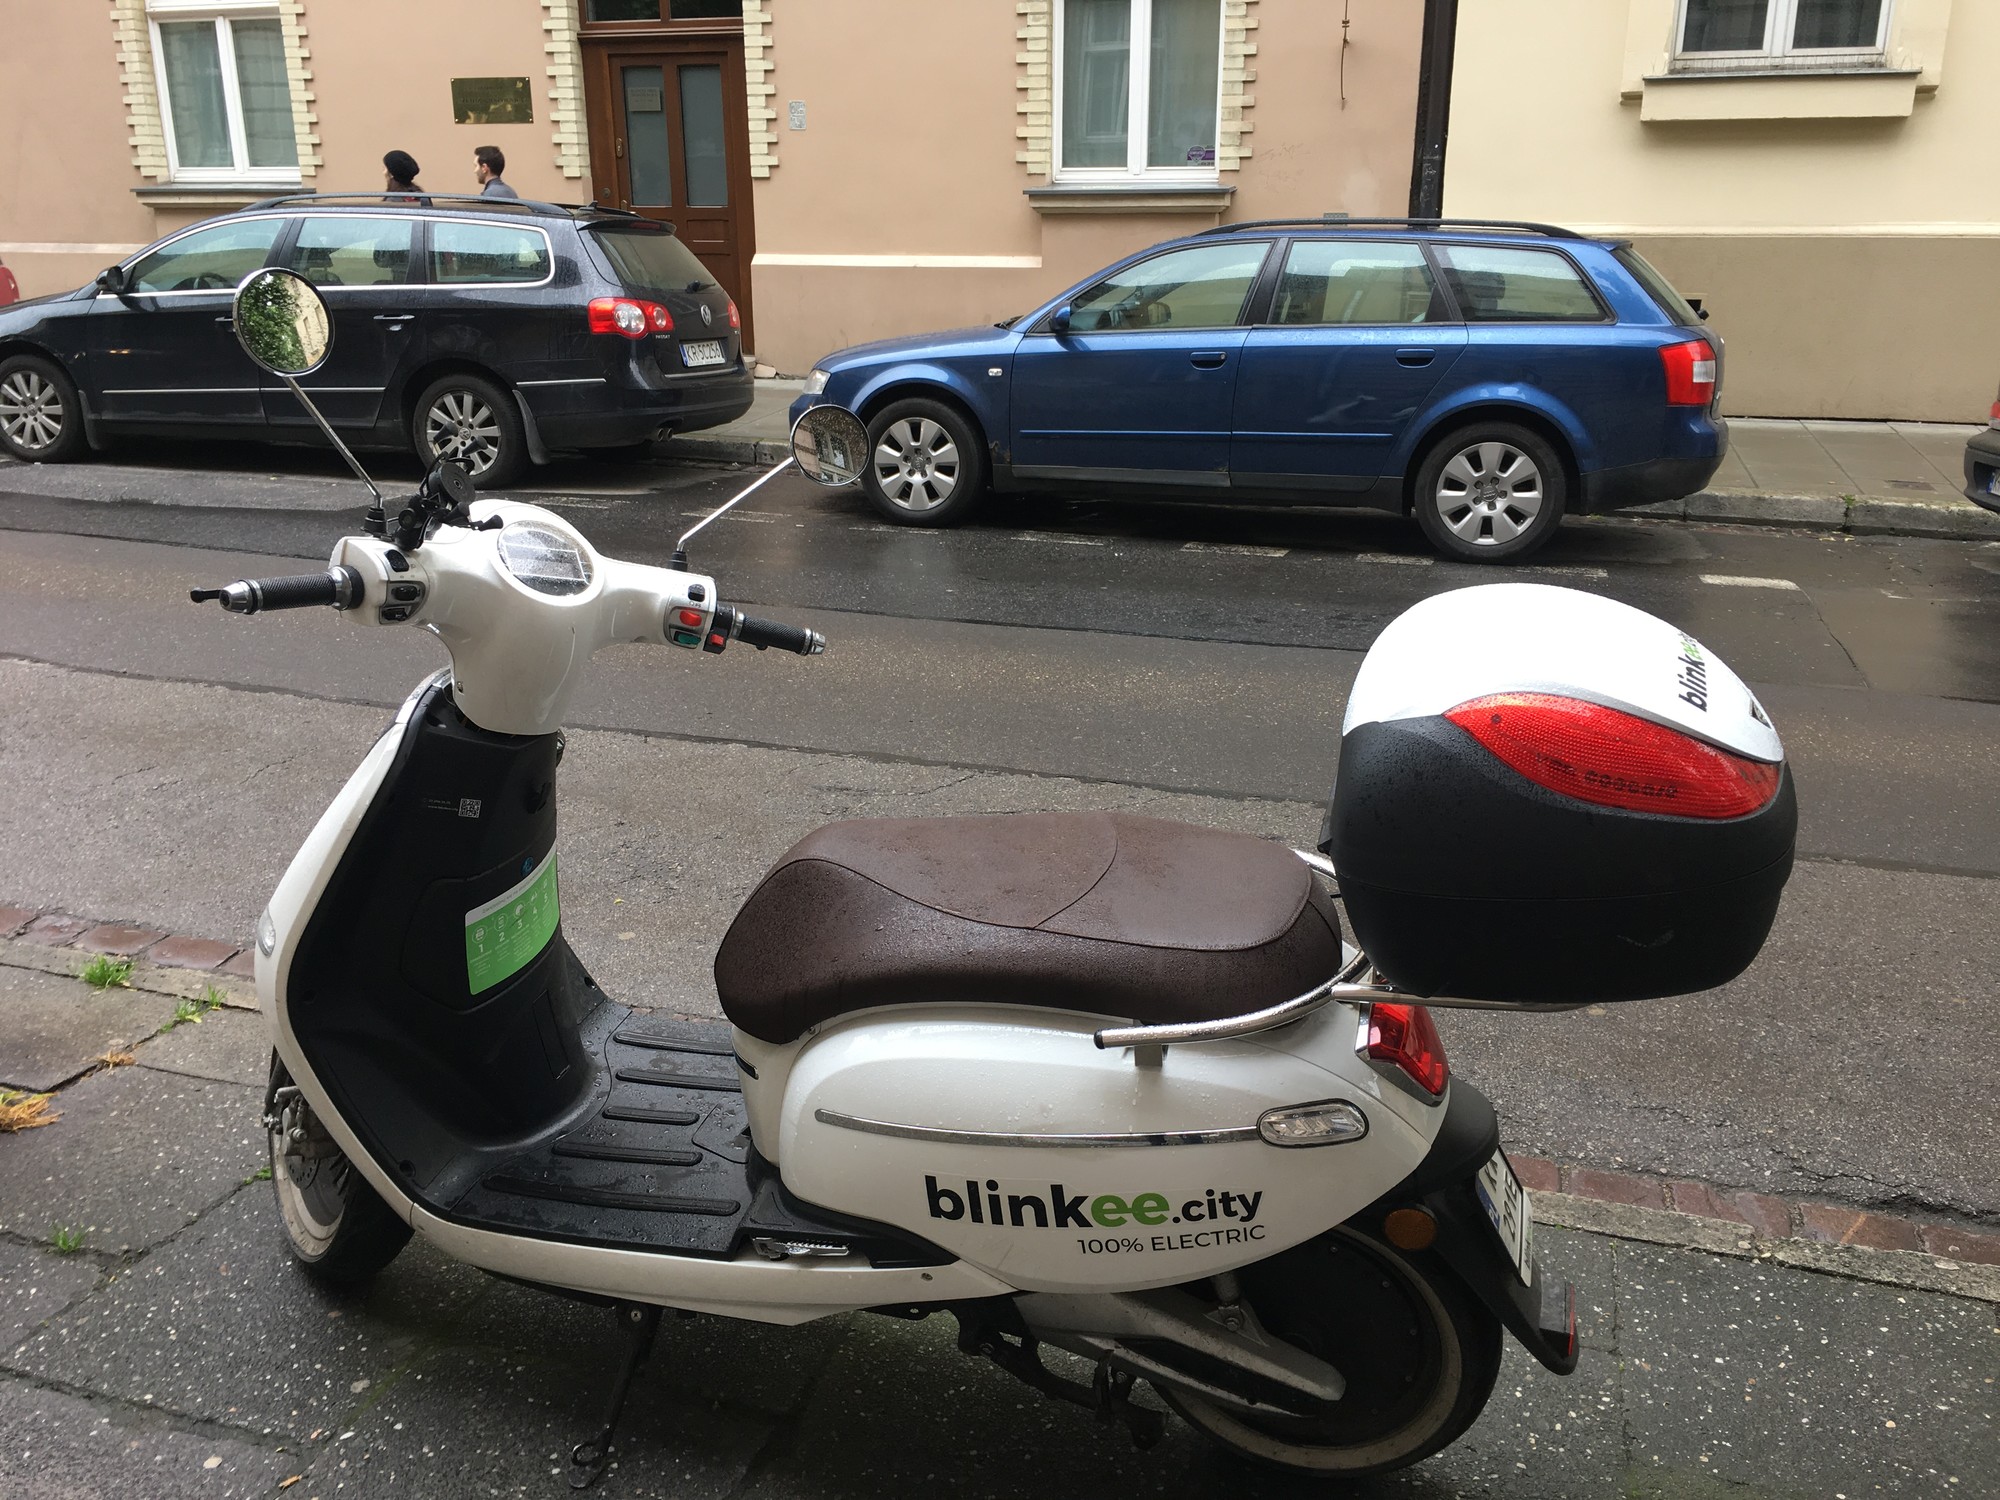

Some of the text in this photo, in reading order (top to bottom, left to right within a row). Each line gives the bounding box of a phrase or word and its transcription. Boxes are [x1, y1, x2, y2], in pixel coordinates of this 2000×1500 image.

[499, 931, 506, 942] 2
[924, 1174, 1263, 1229] blinkee.city
[1077, 1224, 1266, 1254] 100% ELECTRIC
